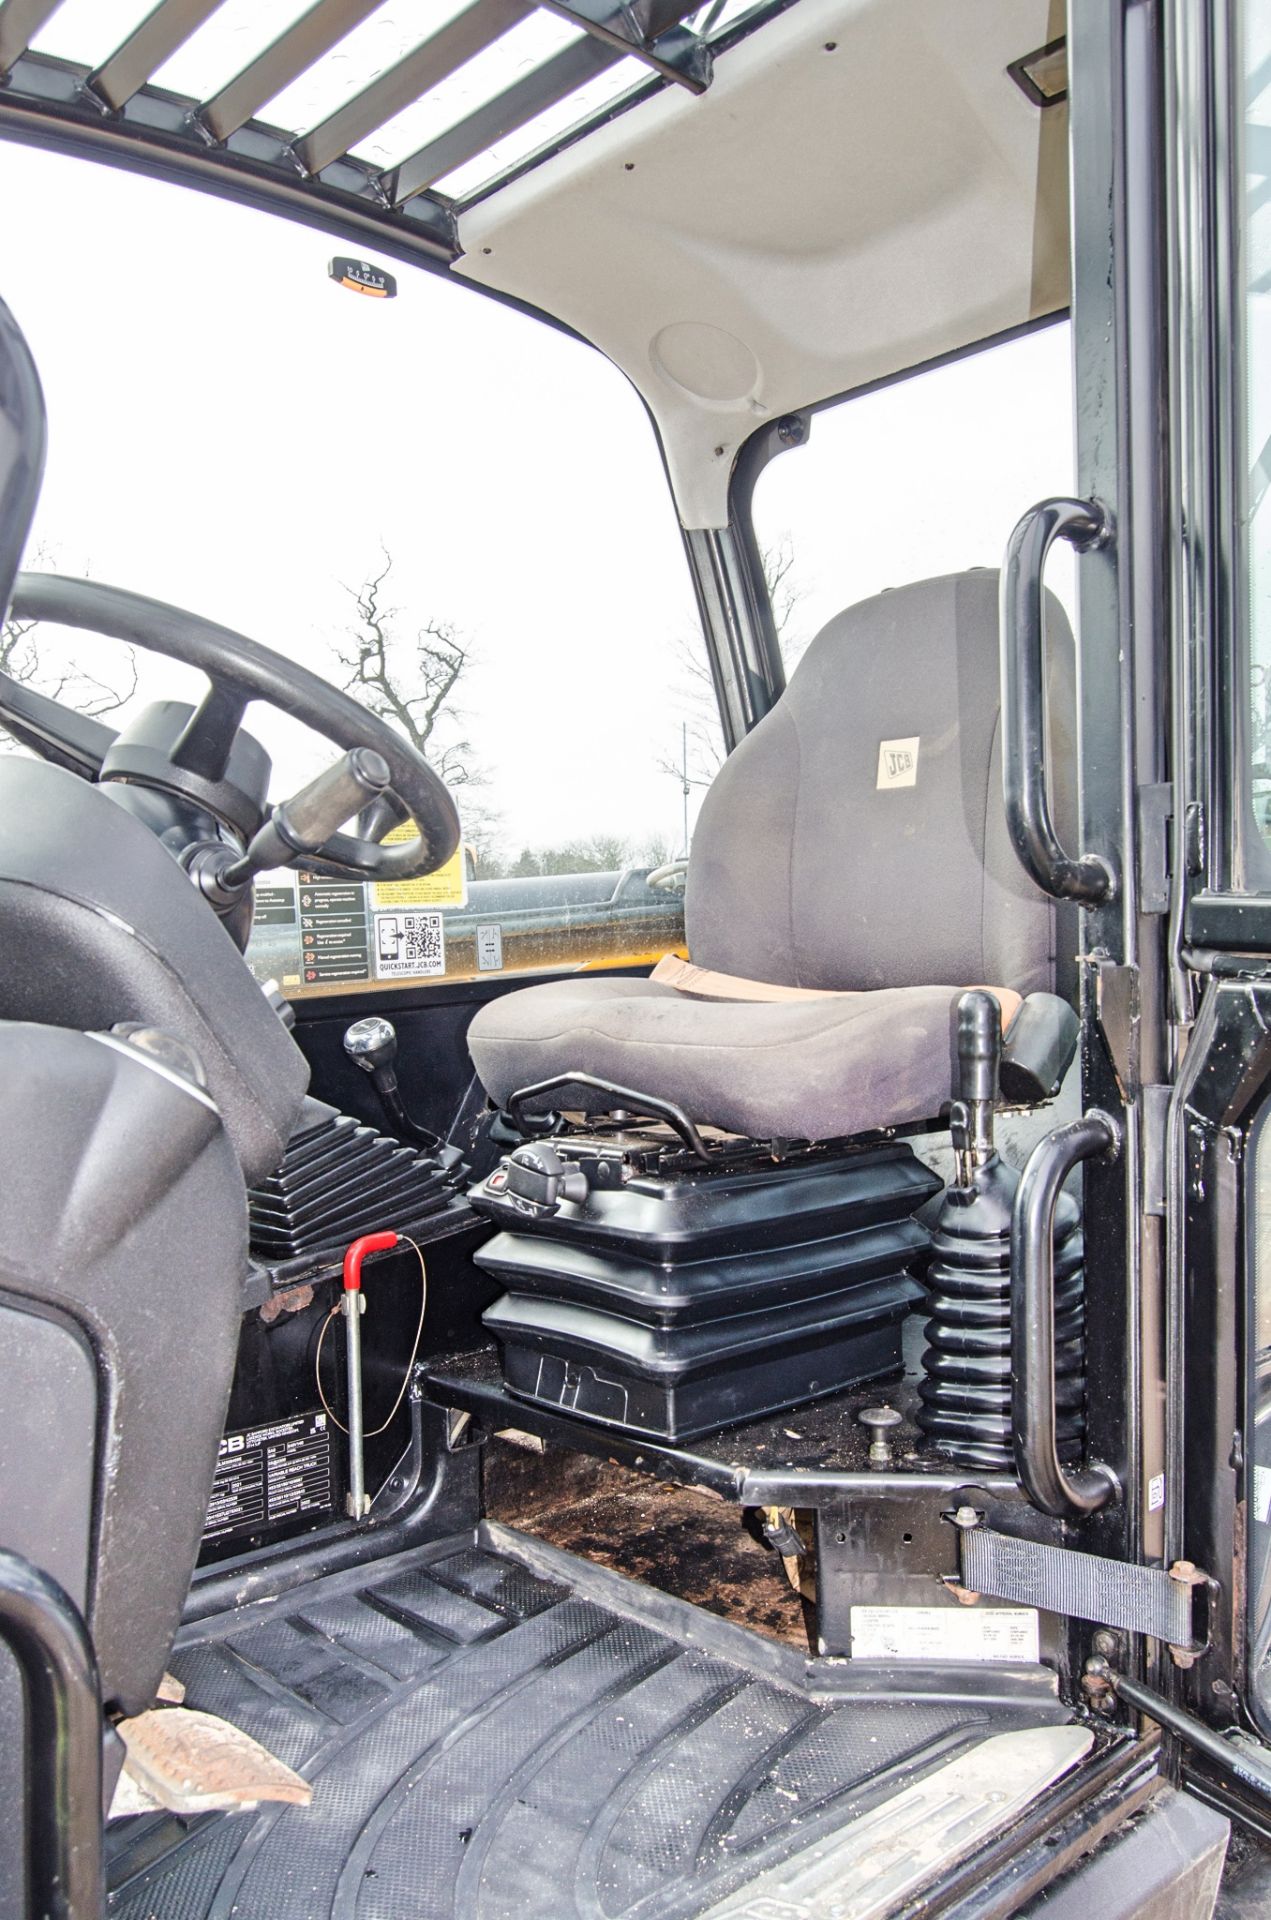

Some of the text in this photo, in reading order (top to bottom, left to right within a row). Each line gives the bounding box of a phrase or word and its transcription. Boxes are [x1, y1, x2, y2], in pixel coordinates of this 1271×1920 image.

[889, 753, 911, 776] JCB
[380, 961, 441, 972] QUICKSTART.JCB.COM
[218, 1435, 245, 1456] CB
